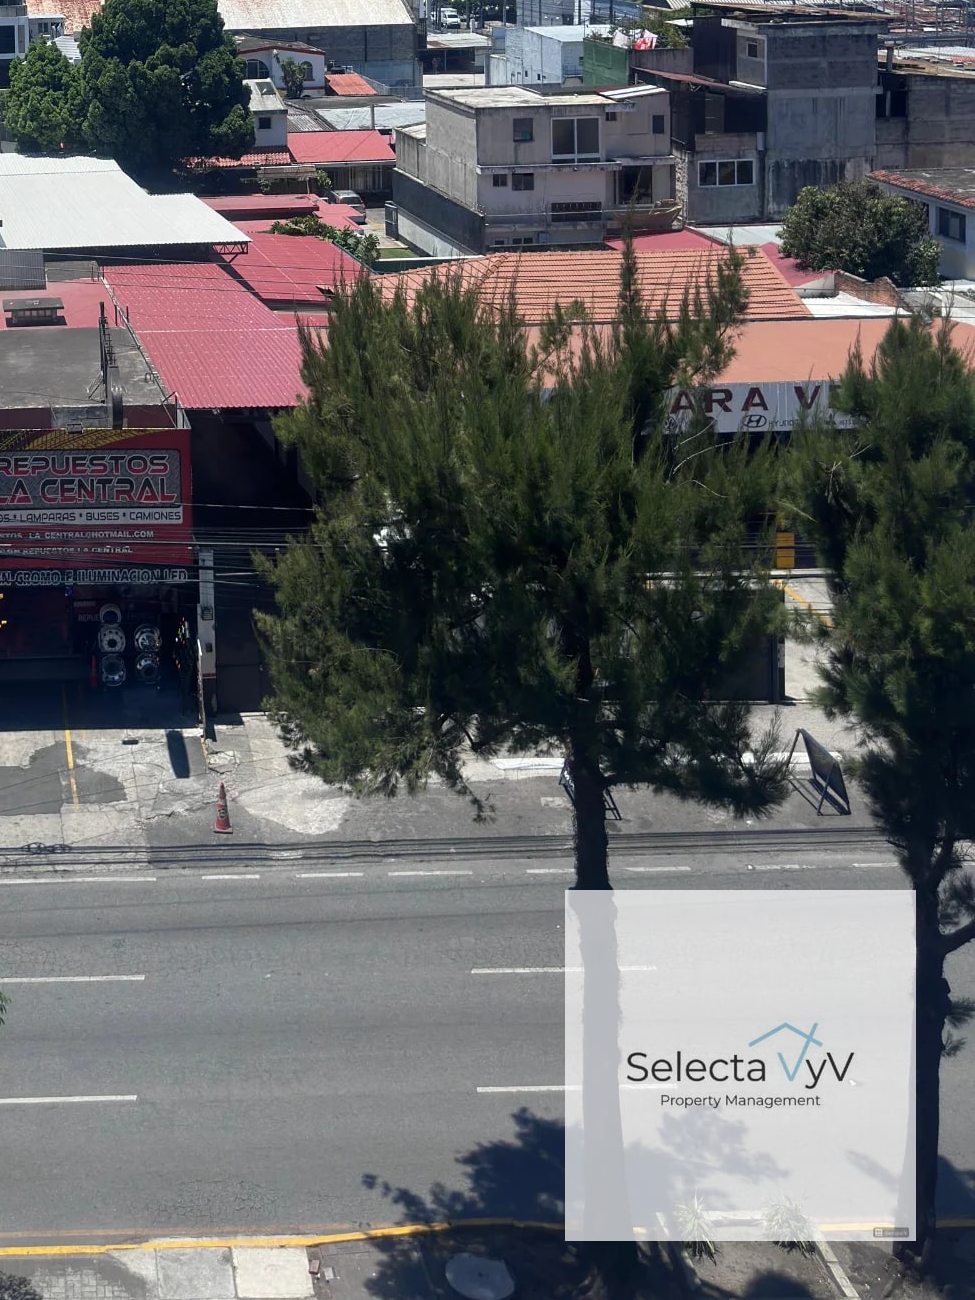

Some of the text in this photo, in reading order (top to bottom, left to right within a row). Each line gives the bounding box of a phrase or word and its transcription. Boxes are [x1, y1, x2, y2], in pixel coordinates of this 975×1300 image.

[39, 476, 178, 504] CENTRAL
[19, 511, 76, 523] LAMPARAS
[85, 510, 120, 522] BUSES
[129, 510, 182, 521] CAMIONES
[14, 570, 61, 586] CROMO
[77, 568, 162, 585] ILUMINACION
